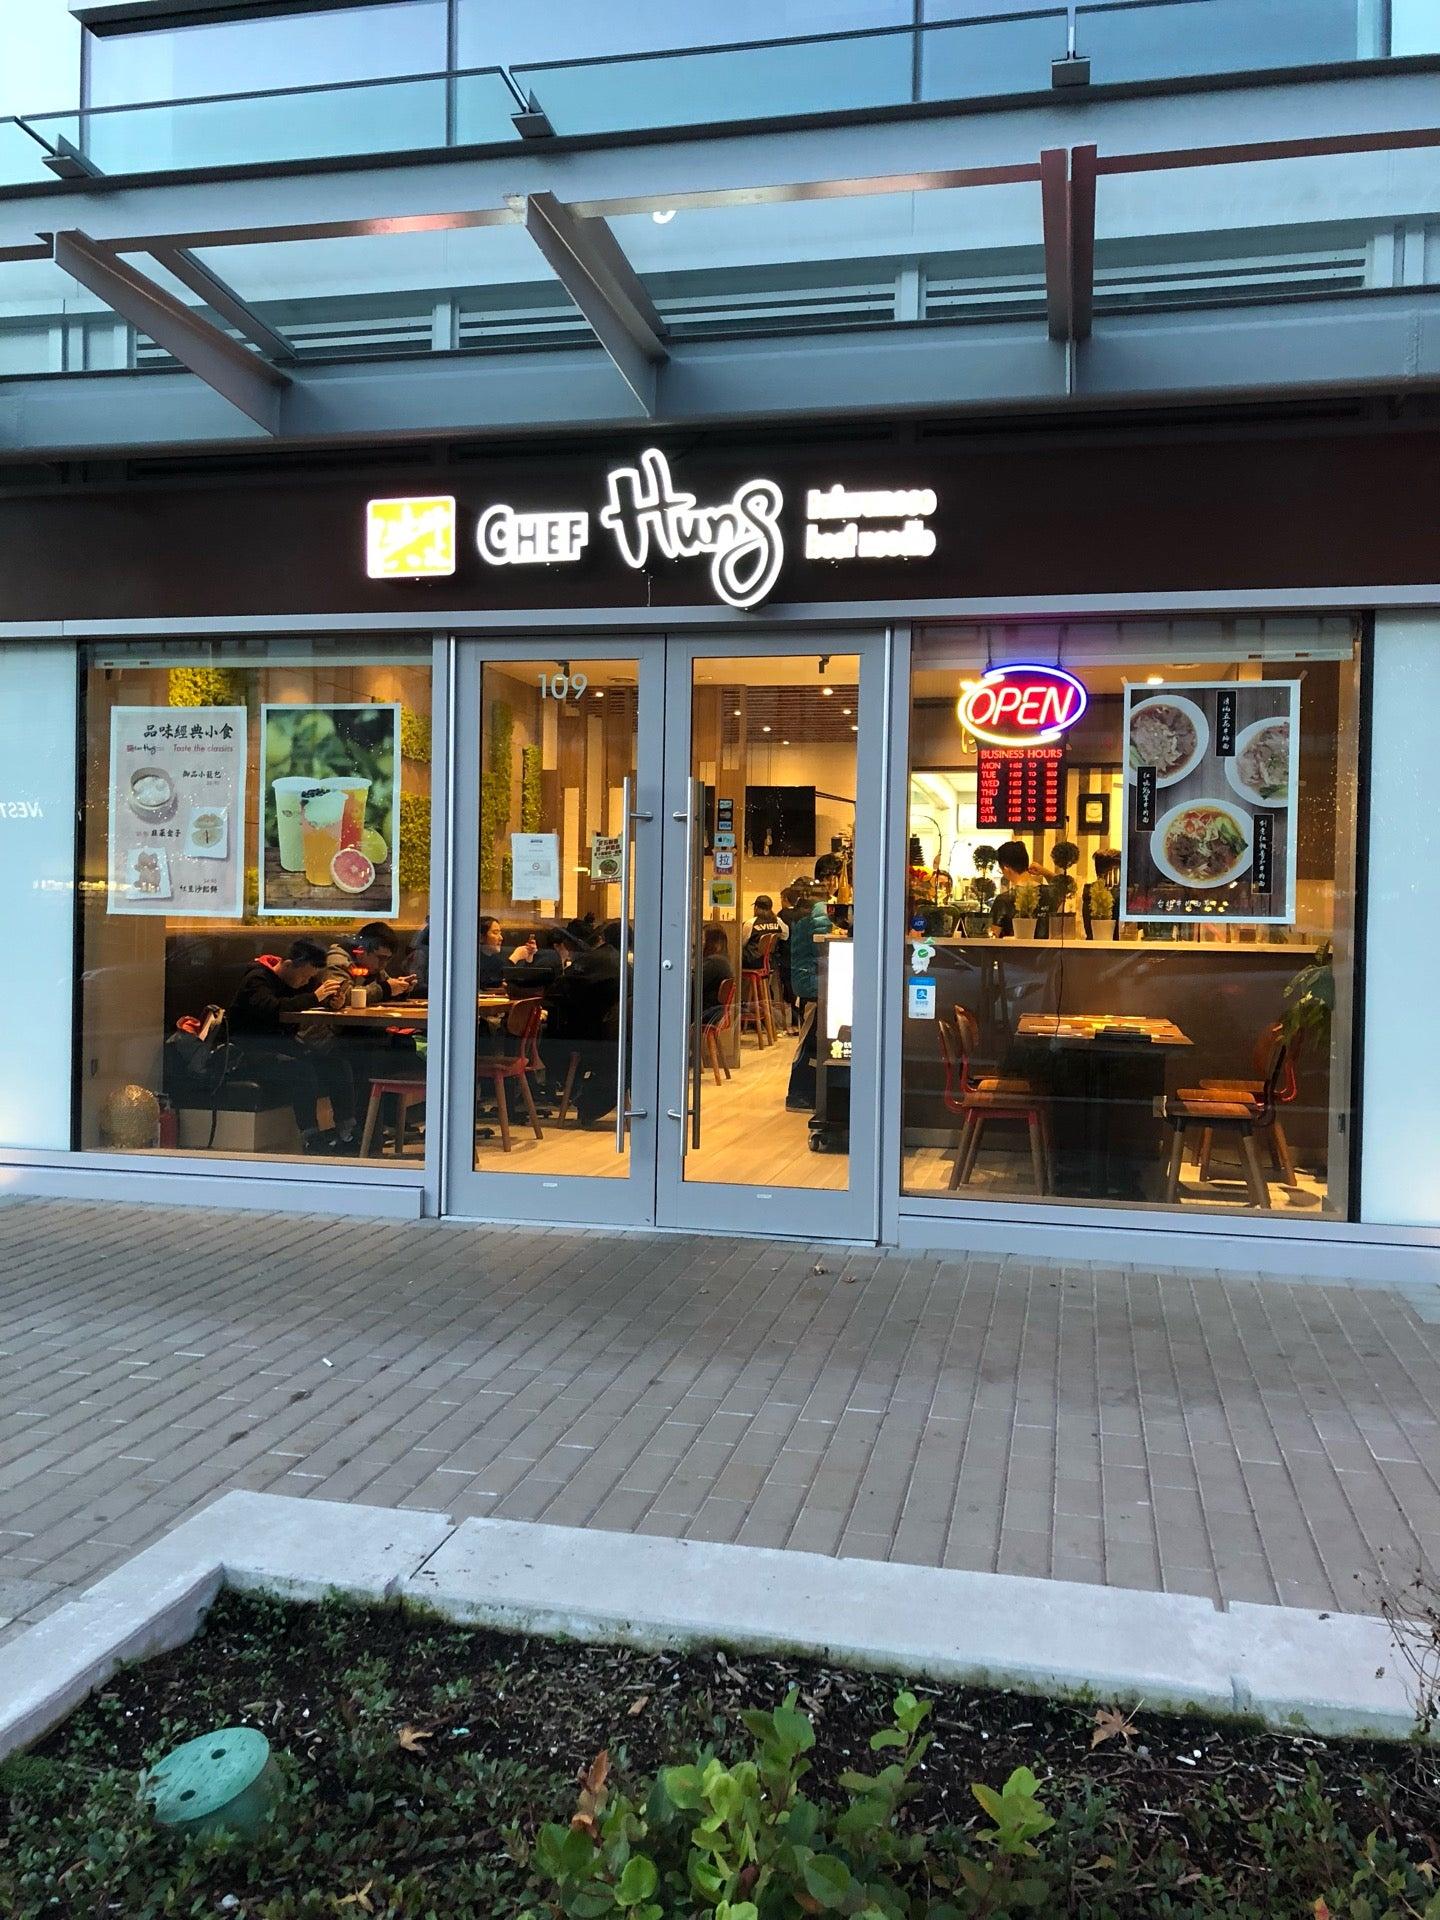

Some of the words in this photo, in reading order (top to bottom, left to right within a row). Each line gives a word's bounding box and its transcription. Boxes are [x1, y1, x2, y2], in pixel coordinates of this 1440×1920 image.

[477, 505, 588, 565] CHEF
[602, 448, 783, 607] Hung
[538, 673, 588, 699] 109
[967, 687, 1075, 725] OPEN
[143, 723, 233, 740] 品味經典小食
[173, 743, 191, 752] Taste
[194, 743, 206, 752] the
[981, 750, 1025, 759] BUSINESS
[1027, 749, 1063, 759] HOURS
[981, 762, 1001, 770] MON
[980, 797, 993, 805] FRI
[980, 806, 995, 814] SAT
[980, 815, 997, 823] SUN
[719, 854, 731, 866] 拉
